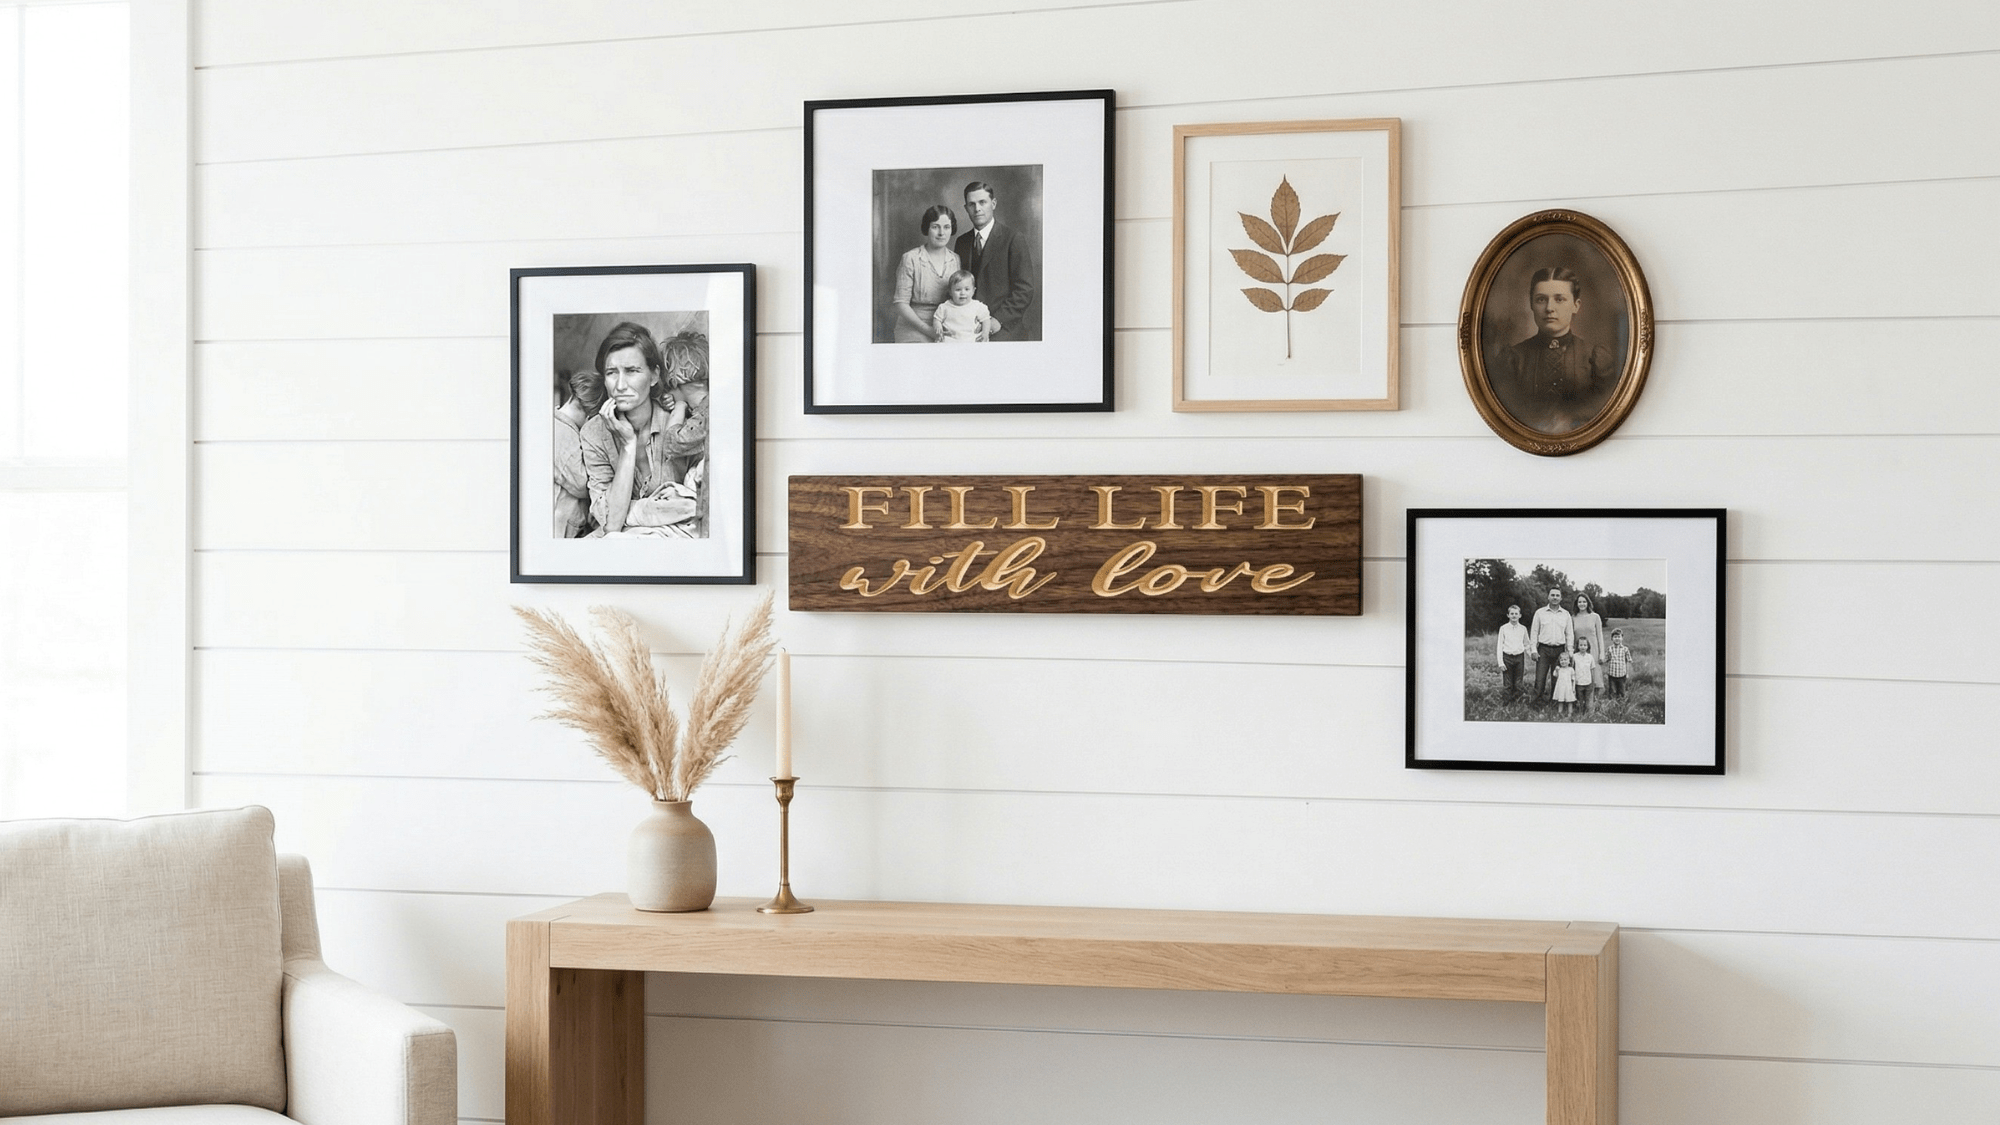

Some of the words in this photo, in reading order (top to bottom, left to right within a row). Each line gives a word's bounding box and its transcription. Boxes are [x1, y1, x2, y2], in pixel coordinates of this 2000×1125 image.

[839, 485, 1060, 530] FILL
[1088, 485, 1316, 530] LIFE
[839, 536, 1058, 600] with
[1091, 540, 1316, 597] love
